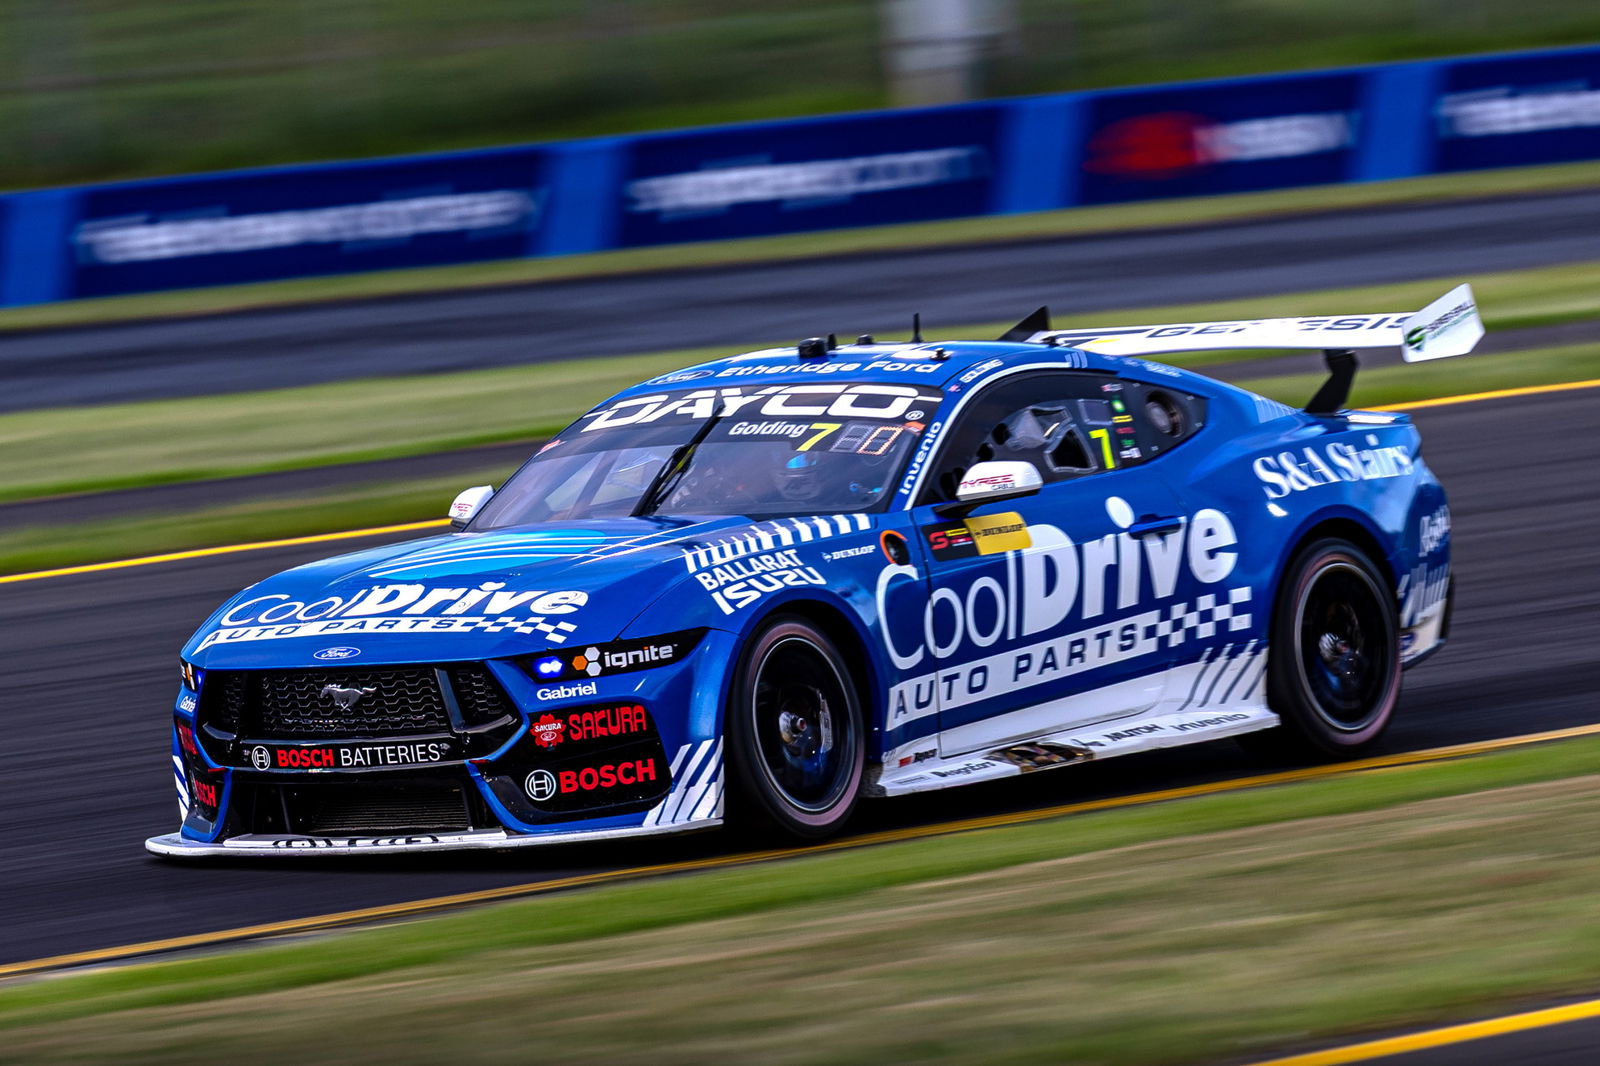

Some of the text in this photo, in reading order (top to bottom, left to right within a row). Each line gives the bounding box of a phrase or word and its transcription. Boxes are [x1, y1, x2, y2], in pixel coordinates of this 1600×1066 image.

[714, 360, 943, 378] Etheridge Ford
[728, 421, 843, 452] Golding 7
[1088, 428, 1116, 469] 7
[830, 544, 877, 560] DUNLOP
[694, 549, 805, 592] BALLARAT
[710, 566, 828, 616] ISUZU
[206, 617, 457, 647] AUTO PARTS
[603, 645, 674, 668] ignite
[893, 622, 1140, 720] AUTO PARTS
[536, 682, 597, 700] Gabriel
[534, 722, 562, 733] SAKURA
[568, 704, 648, 741] SAKURA
[1101, 723, 1167, 742] MUTOH
[276, 743, 442, 768] BOSCH BATTERIES
[558, 758, 657, 794] BOSCH
